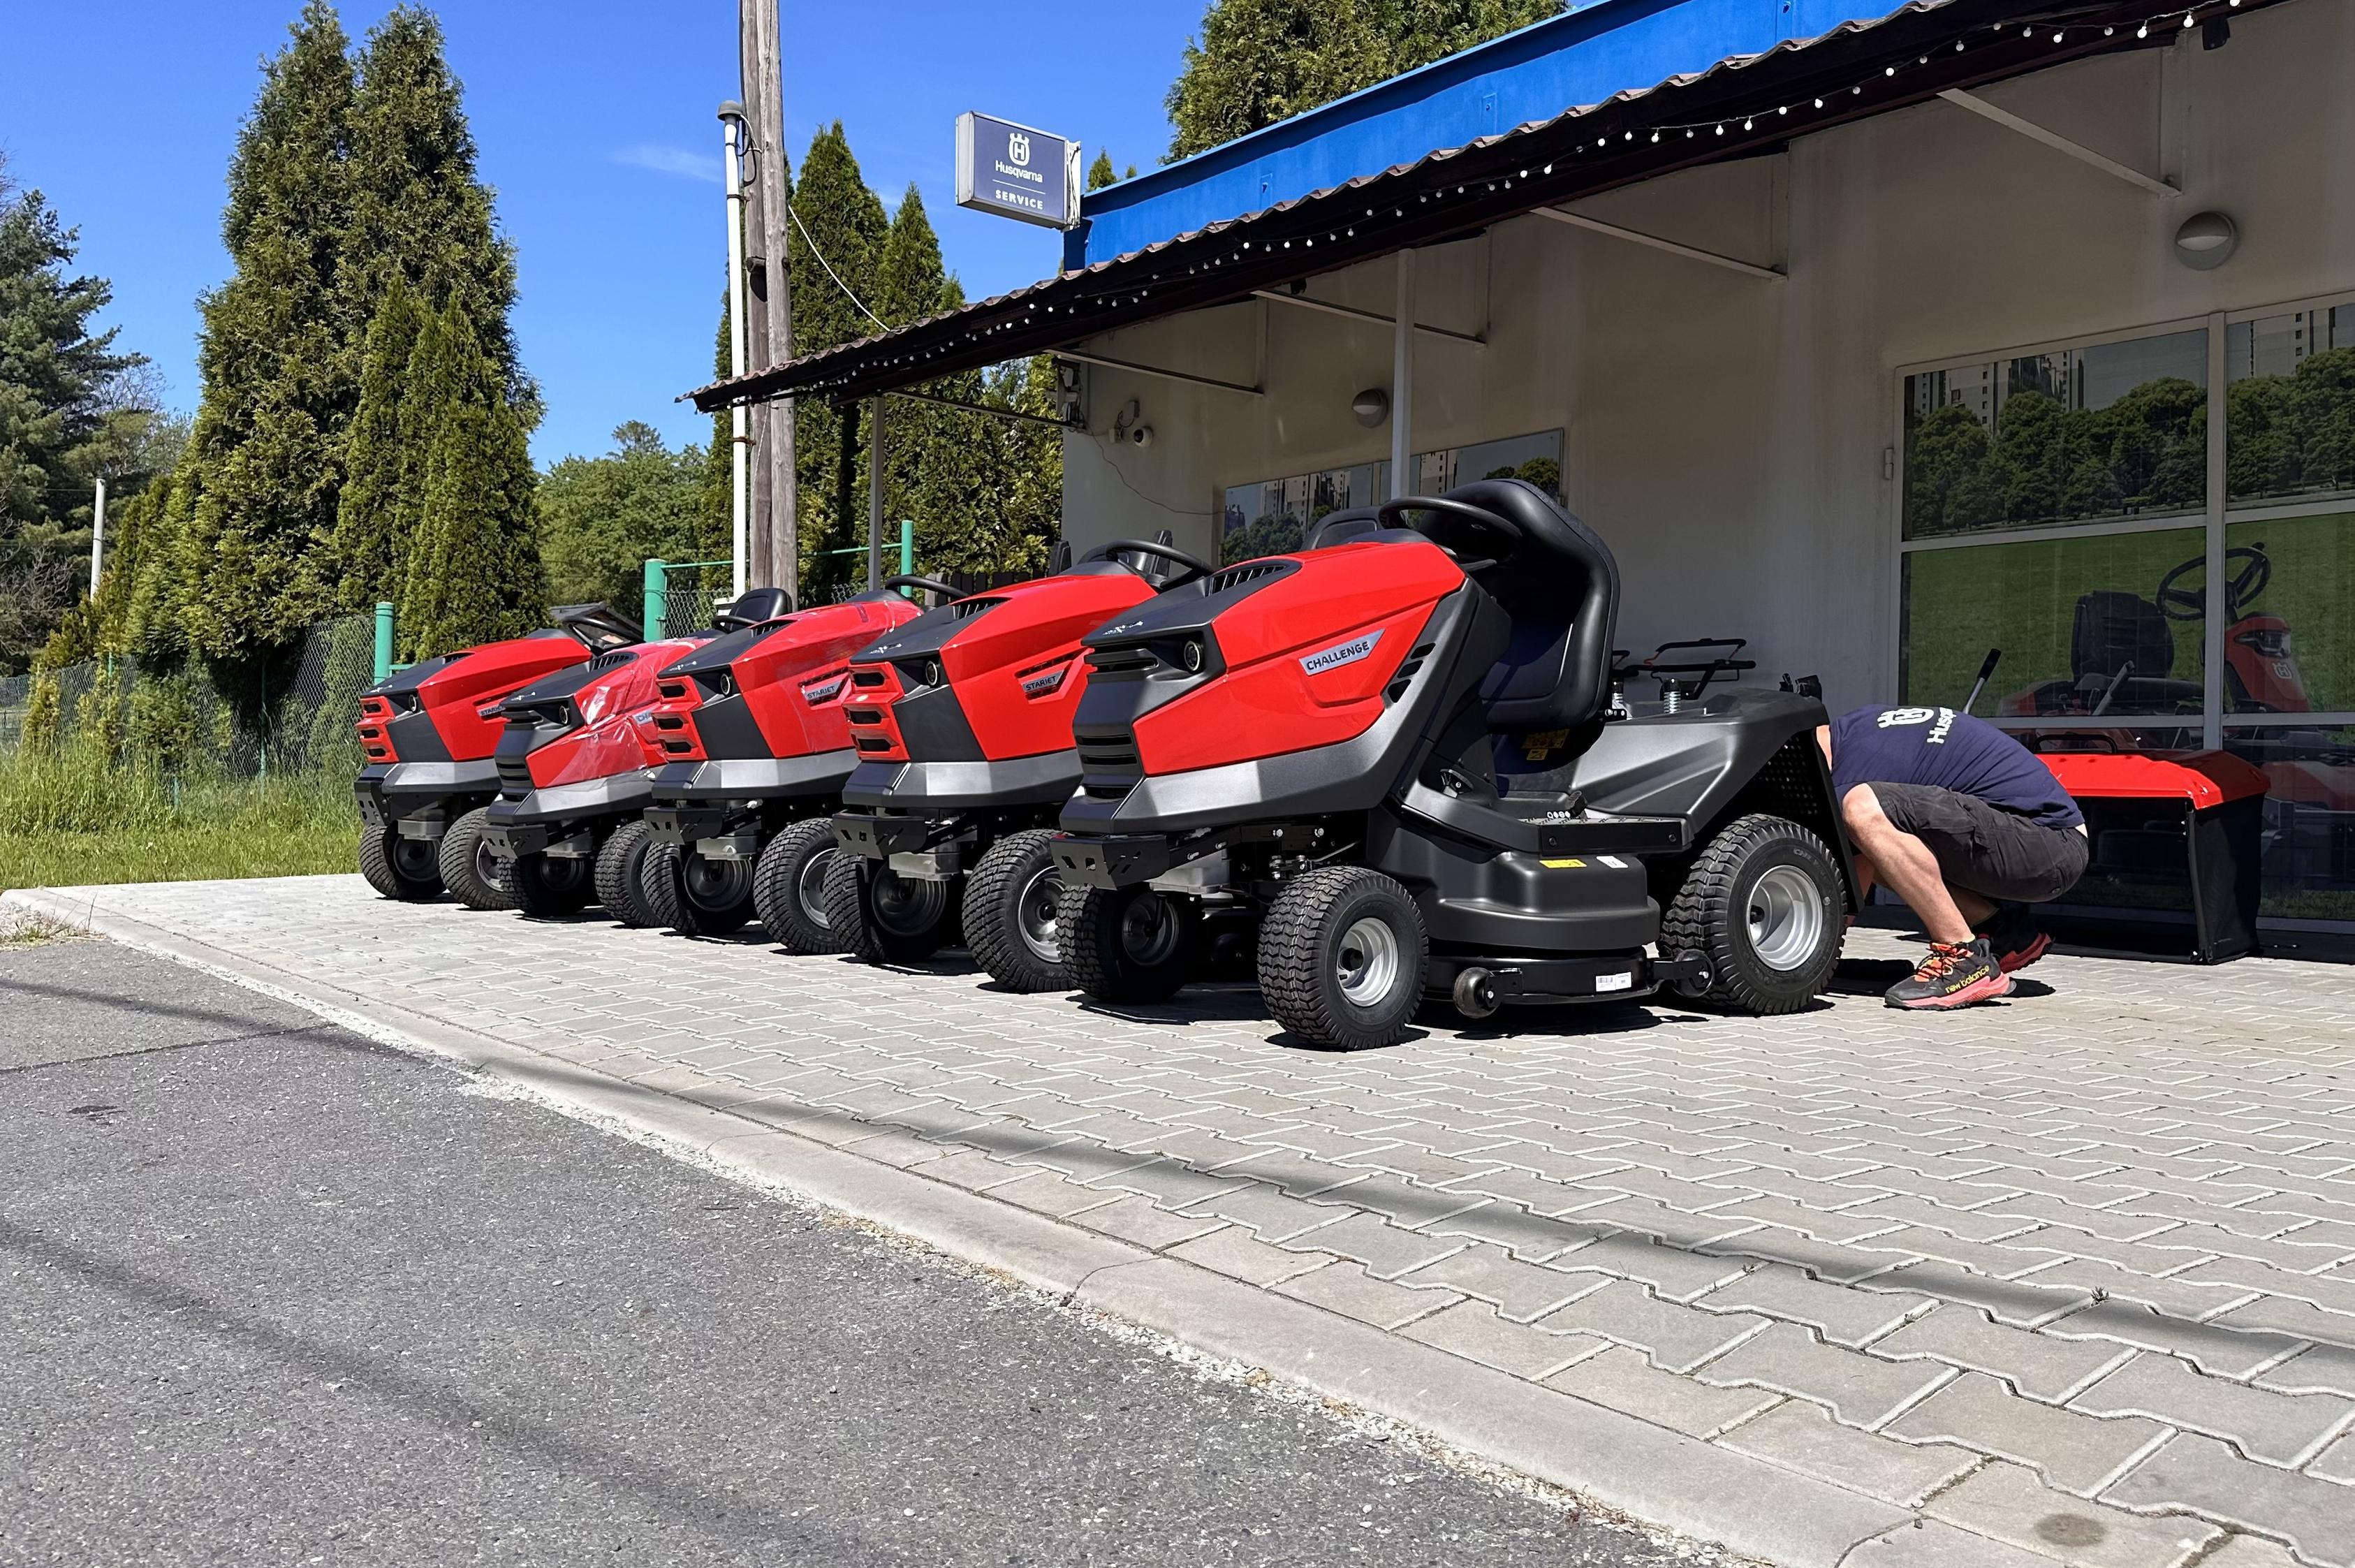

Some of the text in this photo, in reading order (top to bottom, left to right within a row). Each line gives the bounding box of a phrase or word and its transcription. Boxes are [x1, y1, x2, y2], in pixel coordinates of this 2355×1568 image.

[995, 160, 1043, 183] Husqvarna
[995, 189, 1043, 210] SERVICE
[1306, 641, 1370, 671] CHALLENGE
[1945, 965, 1990, 994] new balance
